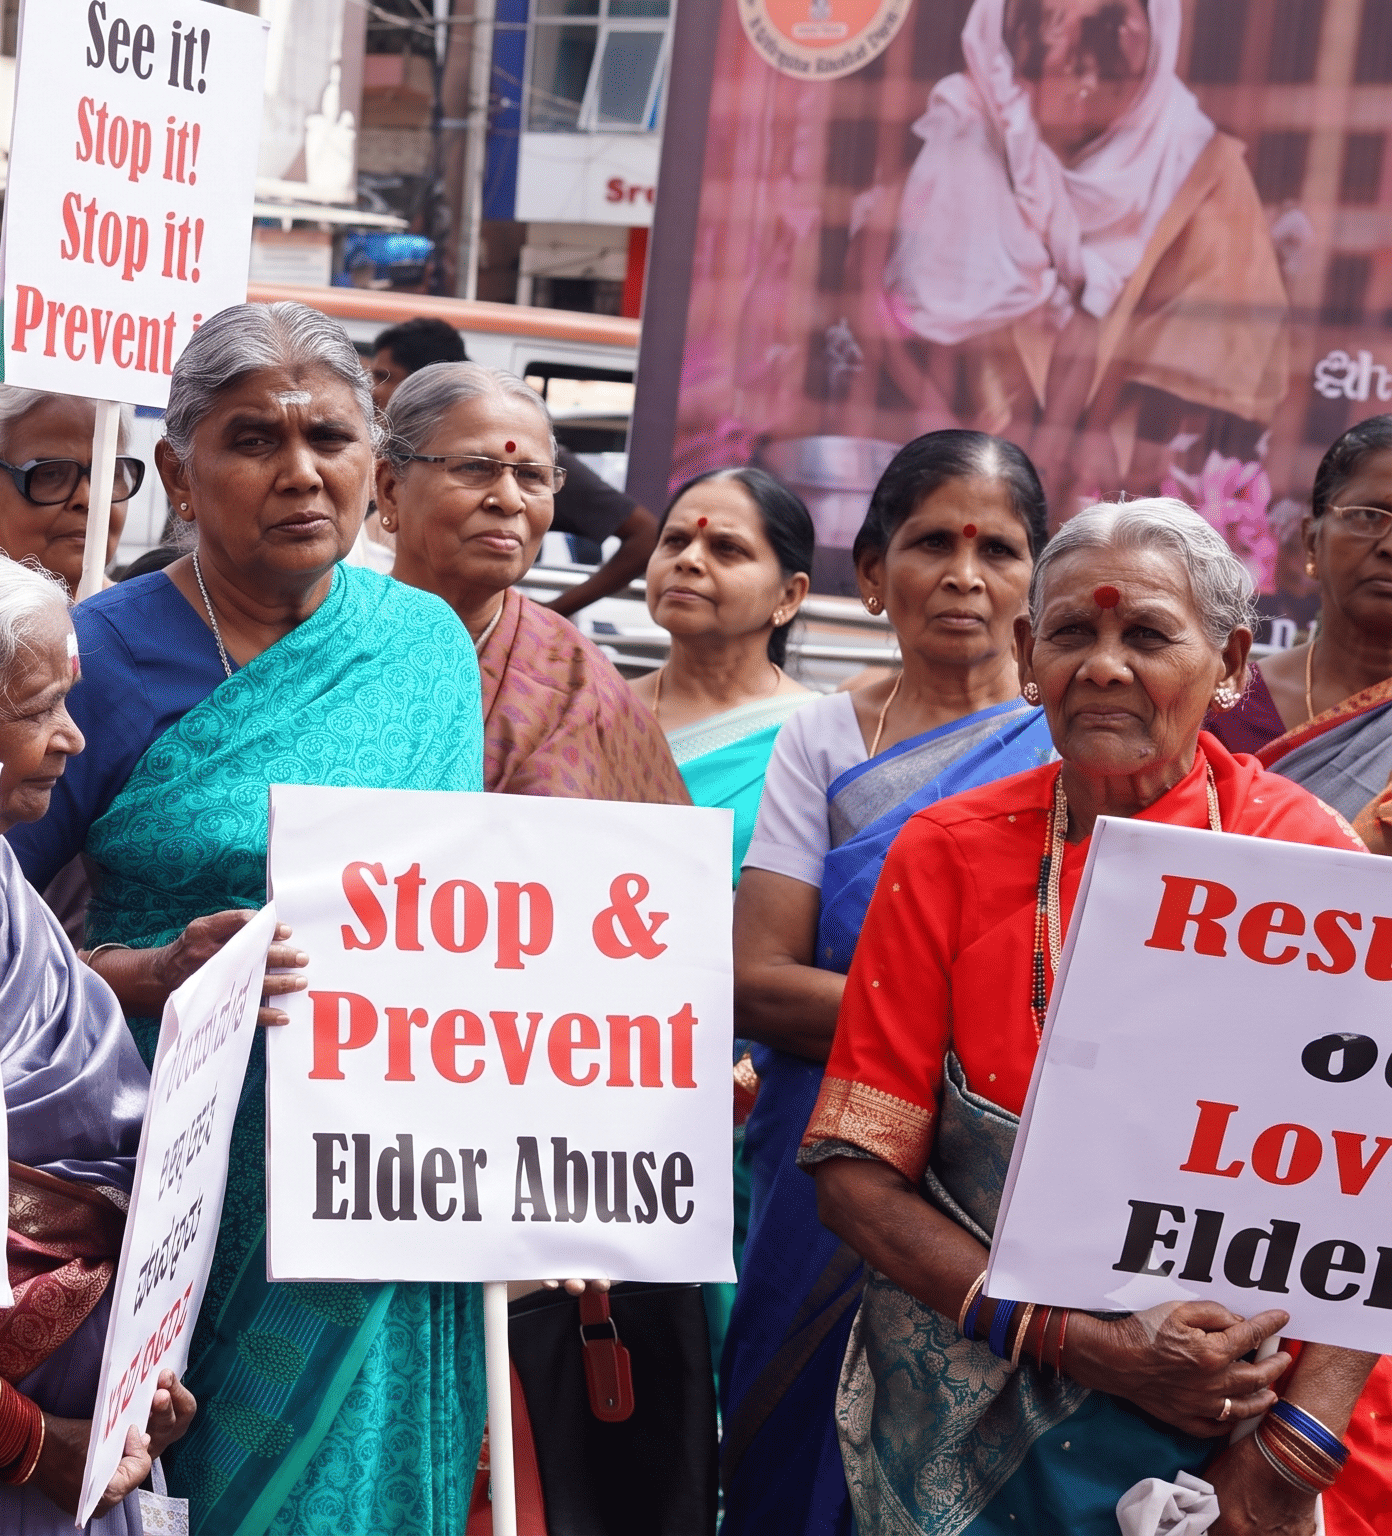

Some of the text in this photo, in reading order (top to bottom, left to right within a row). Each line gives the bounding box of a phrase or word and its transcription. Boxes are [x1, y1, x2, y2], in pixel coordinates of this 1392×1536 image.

[87, 0, 210, 94] See it!
[76, 97, 200, 186] Stop it!
[61, 192, 148, 282] Stop
[162, 212, 204, 283] it!
[12, 285, 176, 375] Prevent
[341, 862, 669, 969] Stop &
[308, 991, 698, 1088] Prevent
[313, 1133, 487, 1221] Elder
[512, 1137, 694, 1224] Abuse
